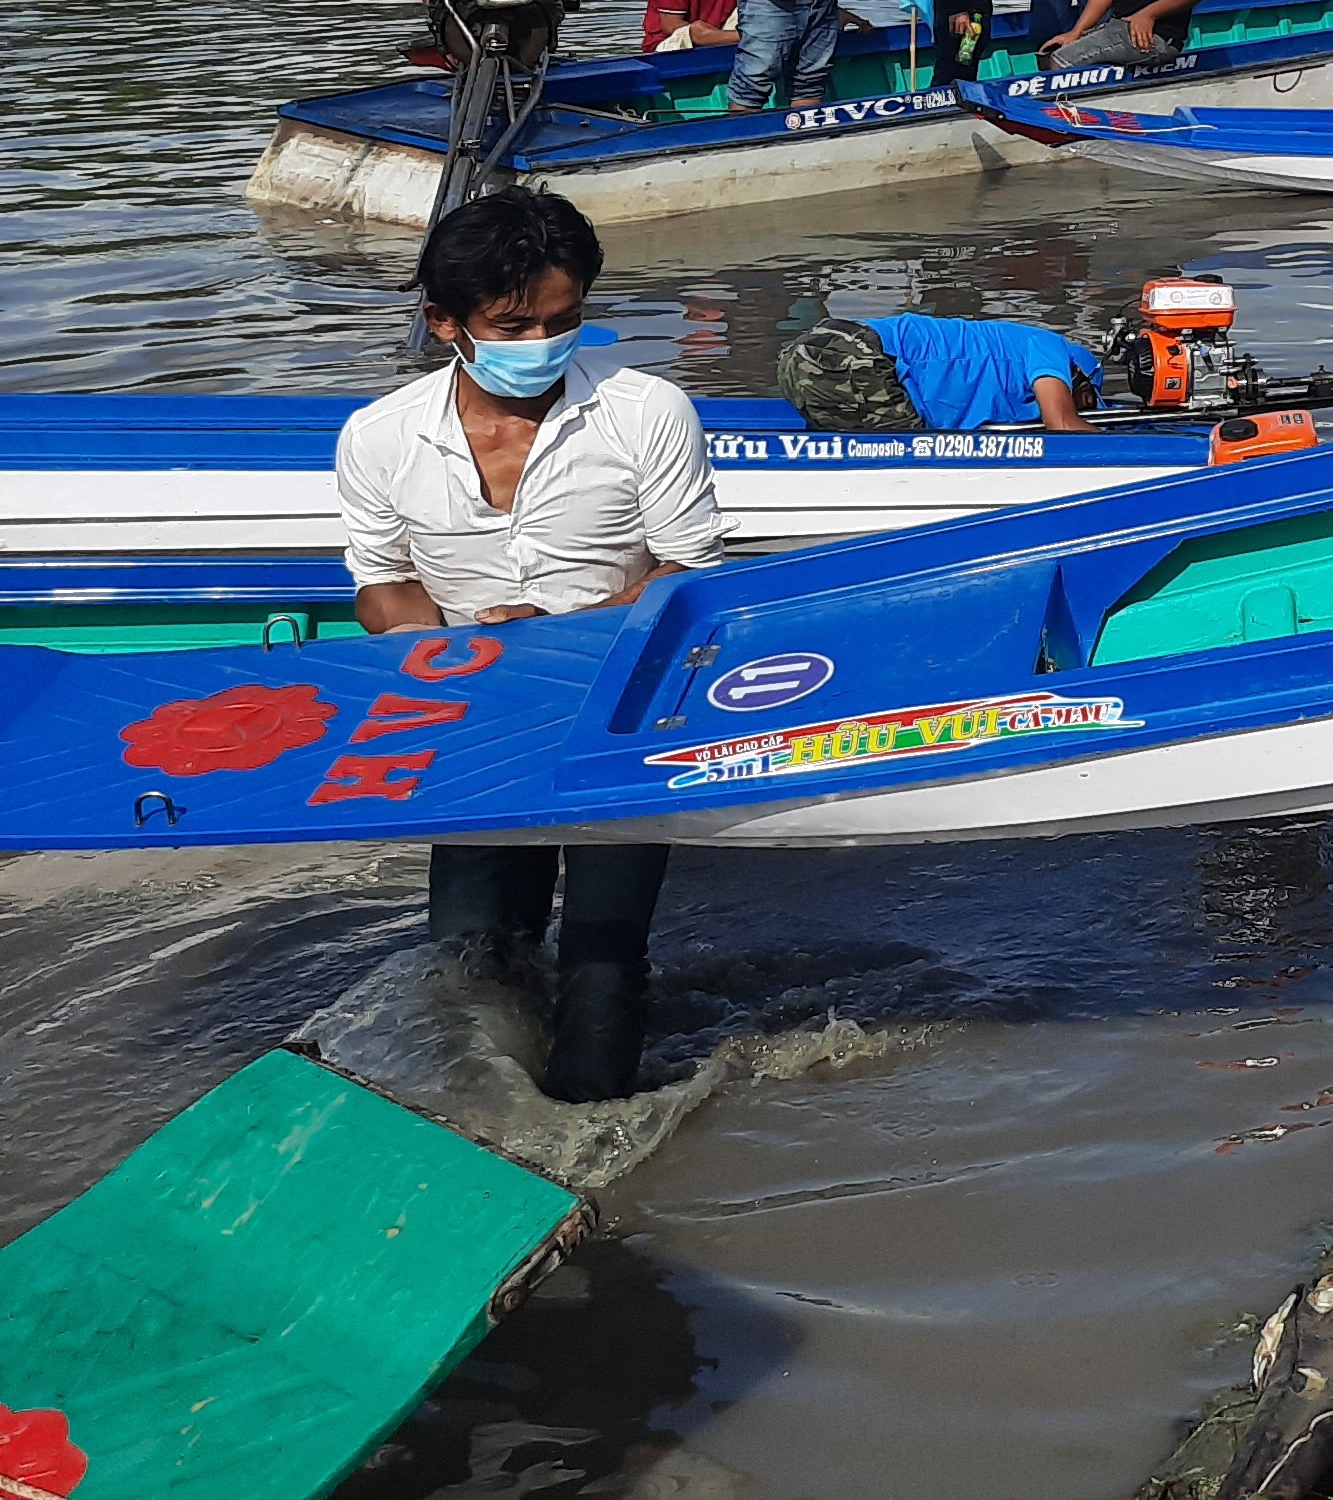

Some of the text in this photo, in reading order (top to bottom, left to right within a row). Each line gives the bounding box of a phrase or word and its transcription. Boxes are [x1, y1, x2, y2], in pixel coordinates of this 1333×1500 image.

[800, 97, 905, 129] HVC
[779, 434, 844, 460] Vui
[848, 437, 905, 458] Composite
[935, 434, 1044, 458] 0290.3871058
[306, 637, 505, 806] HVC
[786, 701, 1112, 766] HỮU VUI CÀ MAU
[736, 740, 758, 753] CAO
